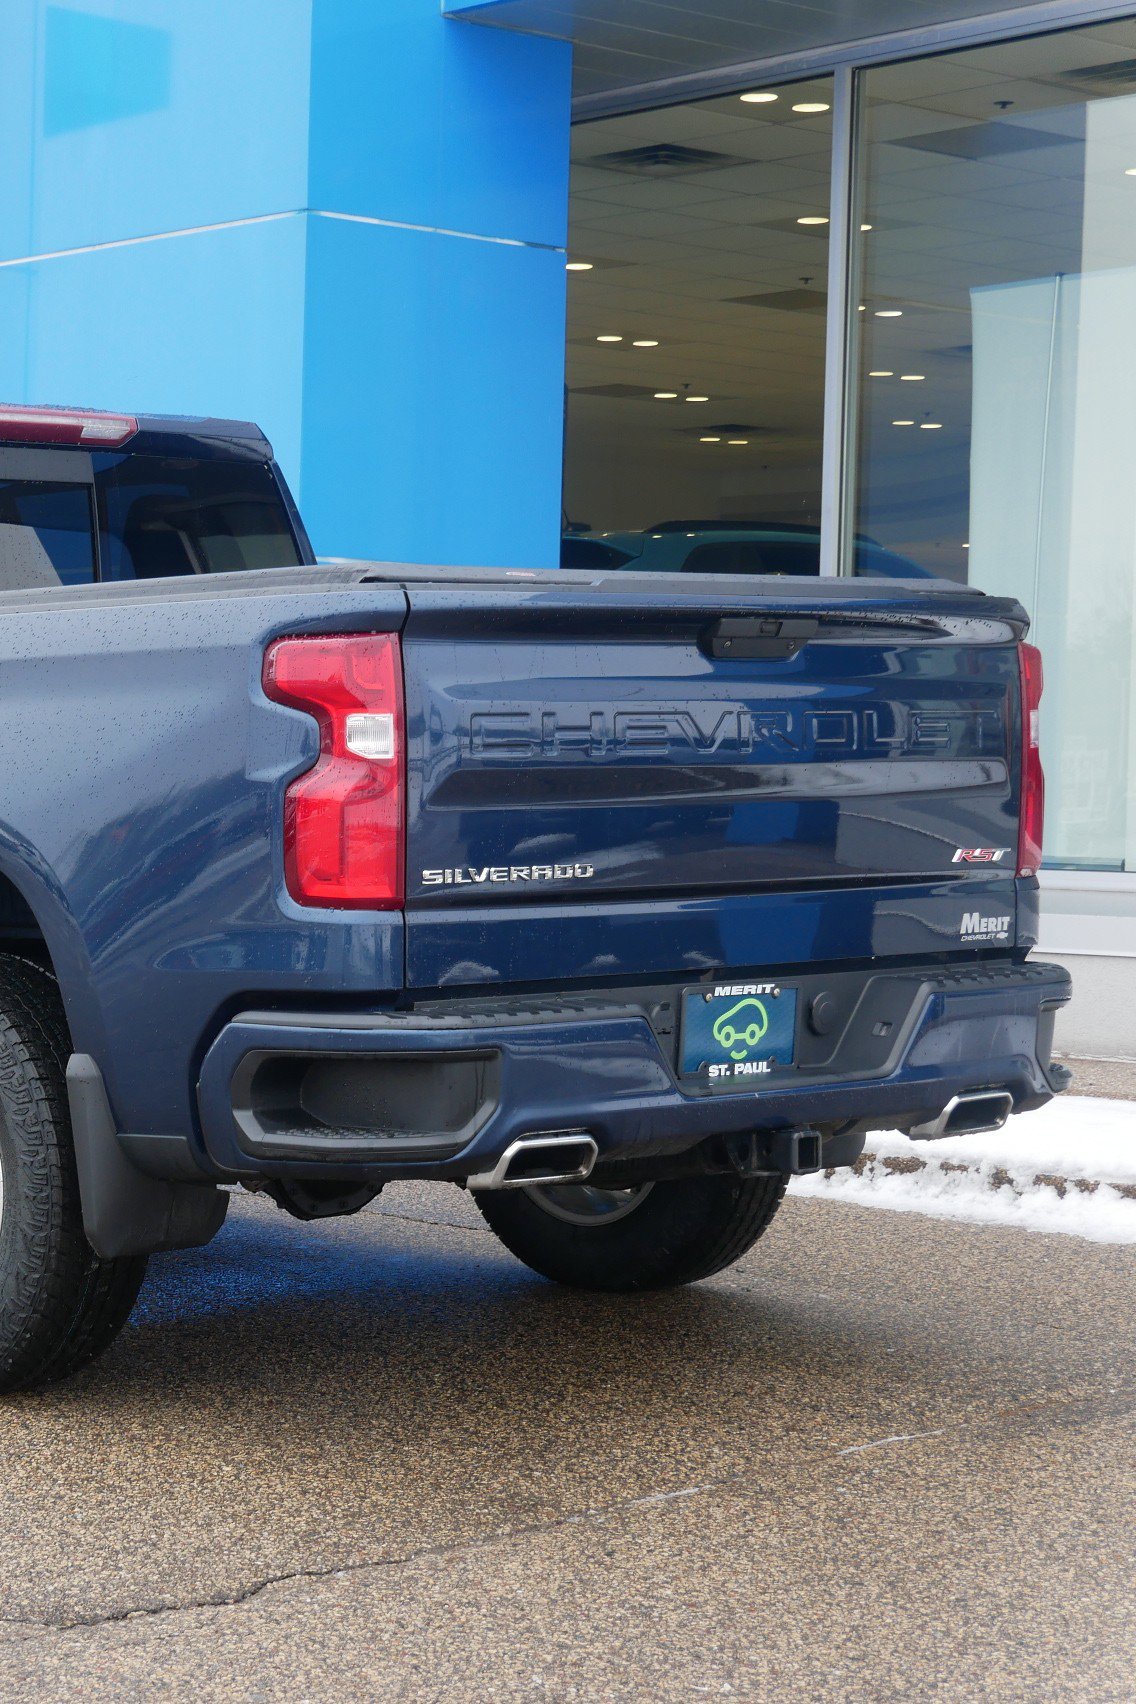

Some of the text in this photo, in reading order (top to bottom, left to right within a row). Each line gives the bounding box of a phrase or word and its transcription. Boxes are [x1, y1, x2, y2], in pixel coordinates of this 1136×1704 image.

[470, 710, 998, 759] CHEVROLET
[951, 848, 1012, 862] RST
[421, 863, 594, 885] SILVERADO
[714, 983, 775, 997] MERIT
[708, 1061, 771, 1077] ST. PAUL
